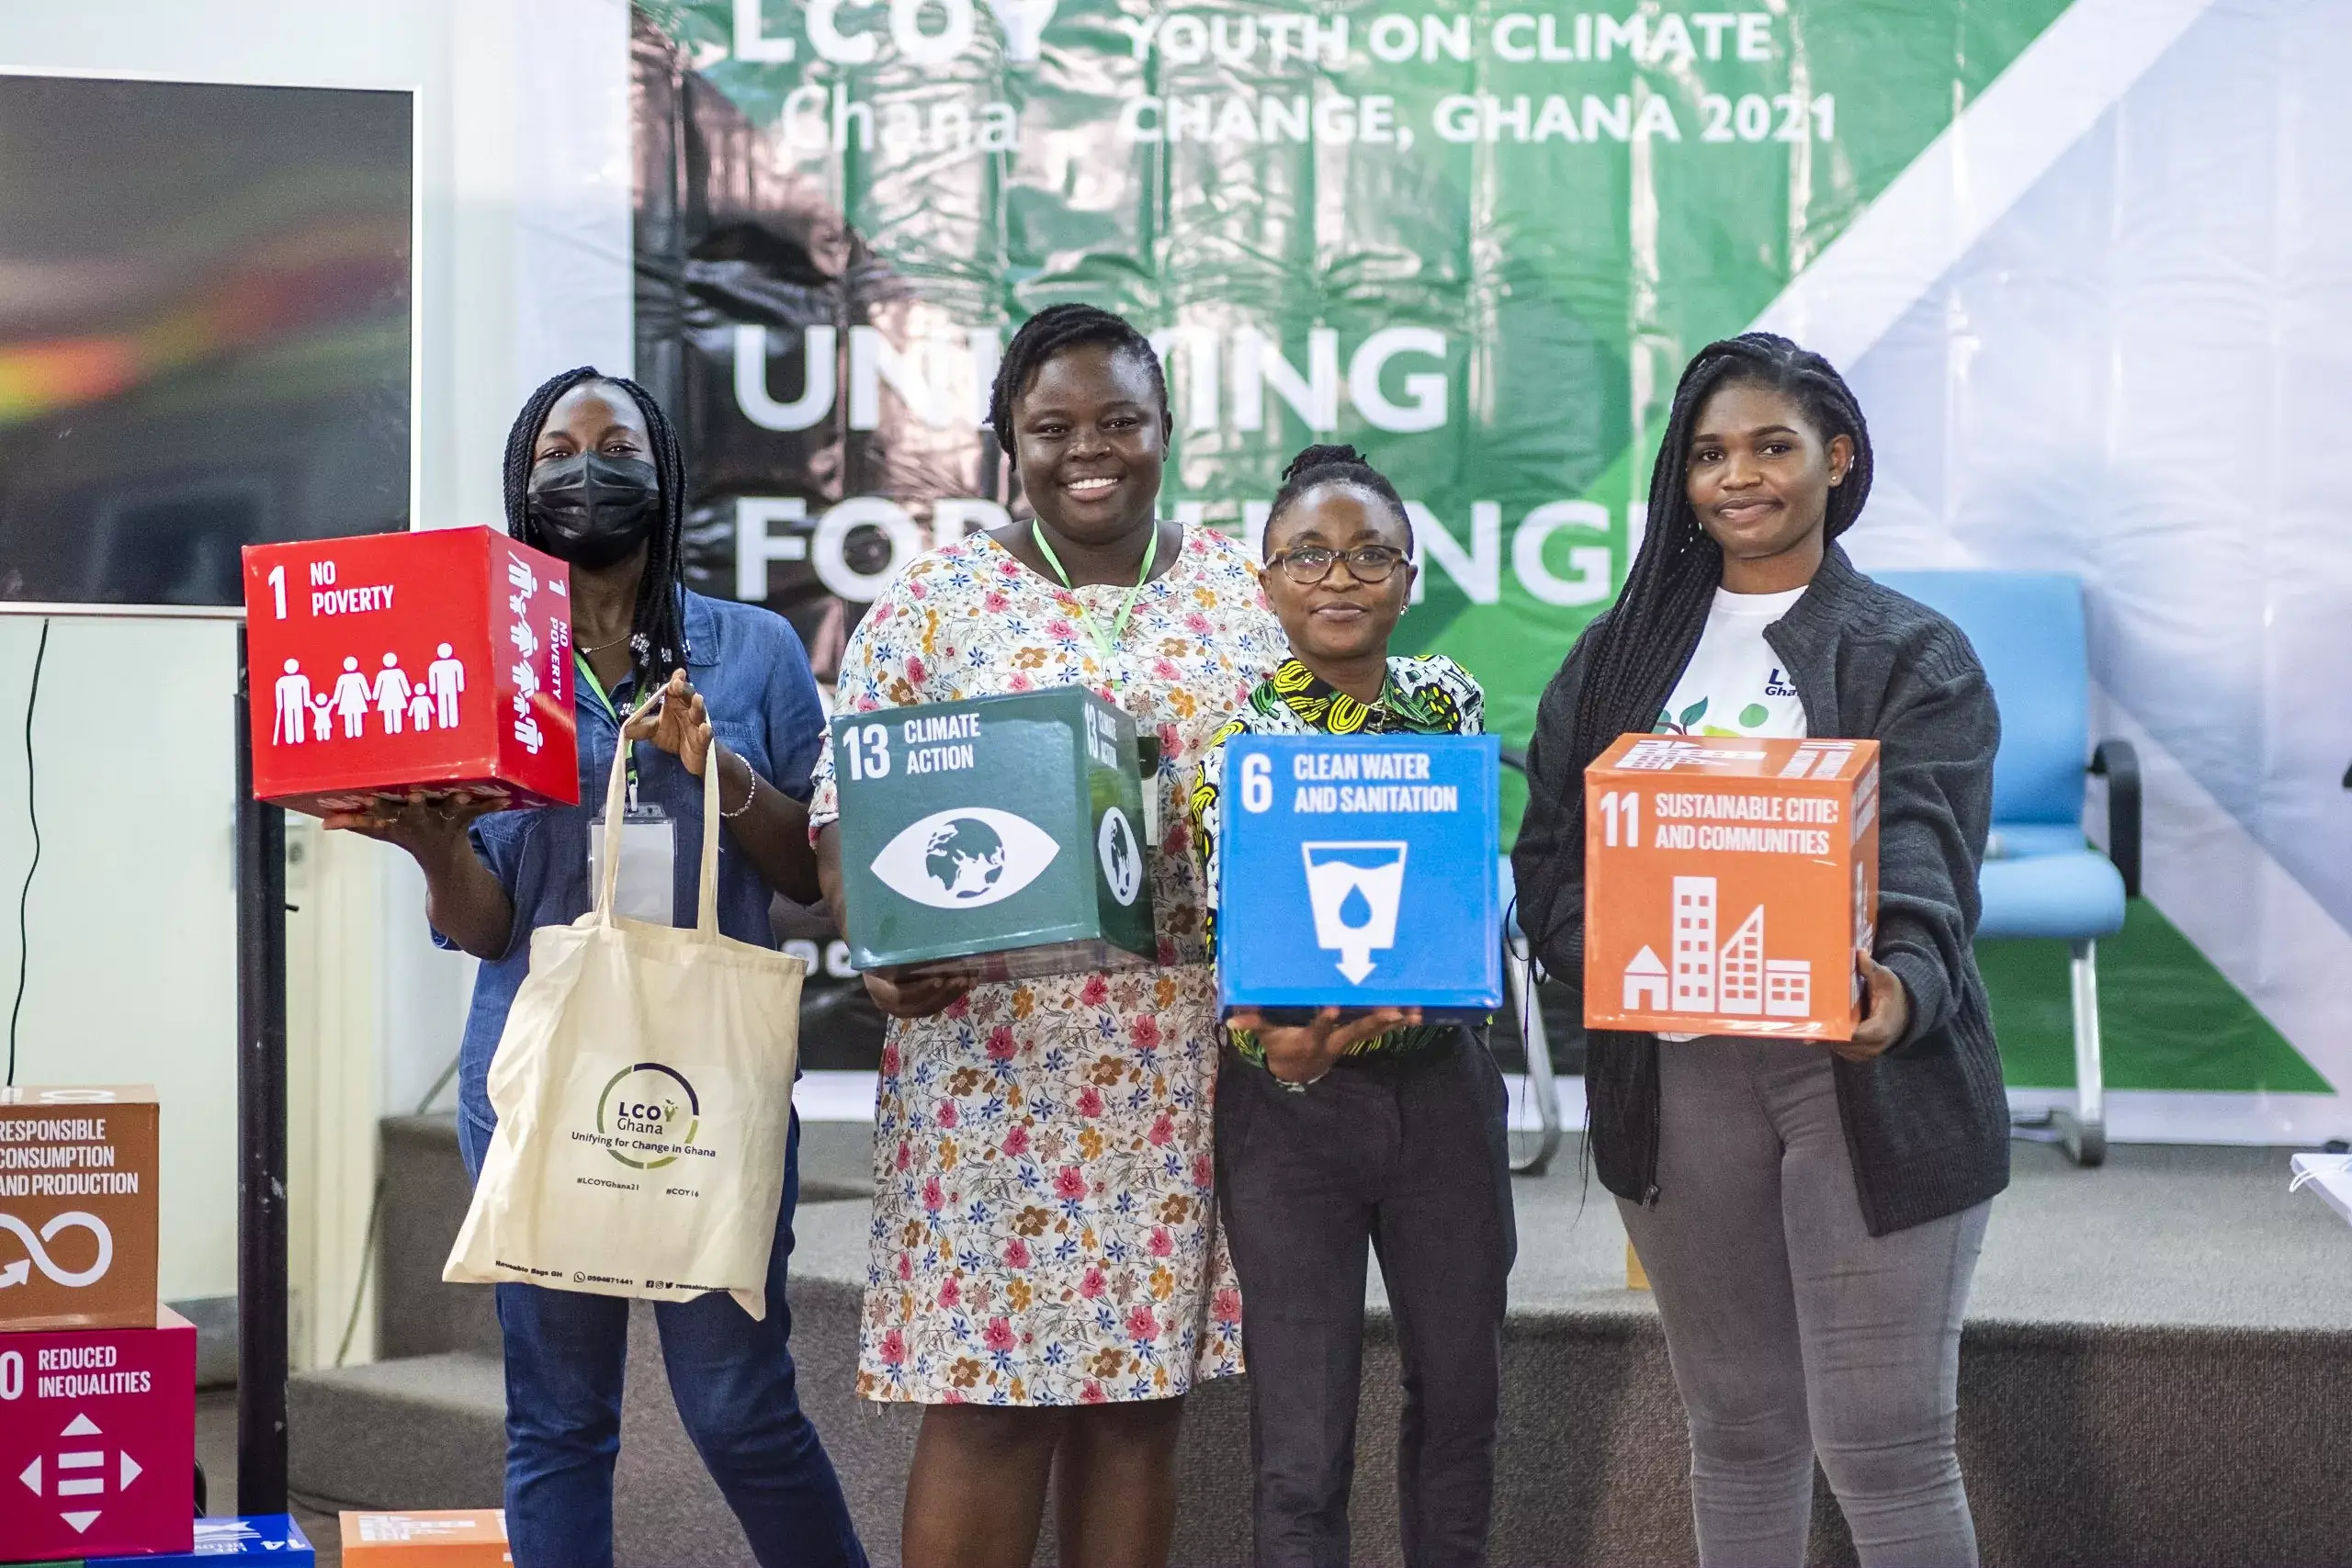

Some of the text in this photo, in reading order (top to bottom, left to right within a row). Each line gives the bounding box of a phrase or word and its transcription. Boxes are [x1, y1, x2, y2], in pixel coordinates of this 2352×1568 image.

[1123, 13, 1771, 63] YOUTH ON CLIMATE
[782, 84, 1020, 152] Ghana
[1122, 93, 1836, 152] CHANGE, GHANA 2021
[311, 560, 335, 586] NO
[267, 565, 287, 620] 1
[312, 585, 394, 616] POVERTY
[560, 621, 569, 648] NO
[550, 616, 561, 700] POVERTY
[1765, 686, 1797, 696] Gha
[904, 713, 981, 744] CLIMATE
[842, 724, 890, 781] 13
[906, 744, 975, 775] ACTION
[1294, 753, 1430, 781] CLEAN WATER
[1241, 752, 1273, 814] 6
[1293, 785, 1459, 813] AND SANITATION
[1655, 793, 1782, 822] SUSTAINABLE
[1600, 791, 1639, 848] 11
[1655, 825, 1830, 856] AND COMMUNITIES
[617, 1118, 663, 1134] Ghana
[571, 1132, 716, 1156] Unifying for Change in Ghana
[32, 1172, 138, 1196] PRODUCTION
[577, 1178, 639, 1190] #LCOYGhana21
[38, 1346, 118, 1371] REDUCED
[38, 1371, 152, 1398] INEQUALITIES
